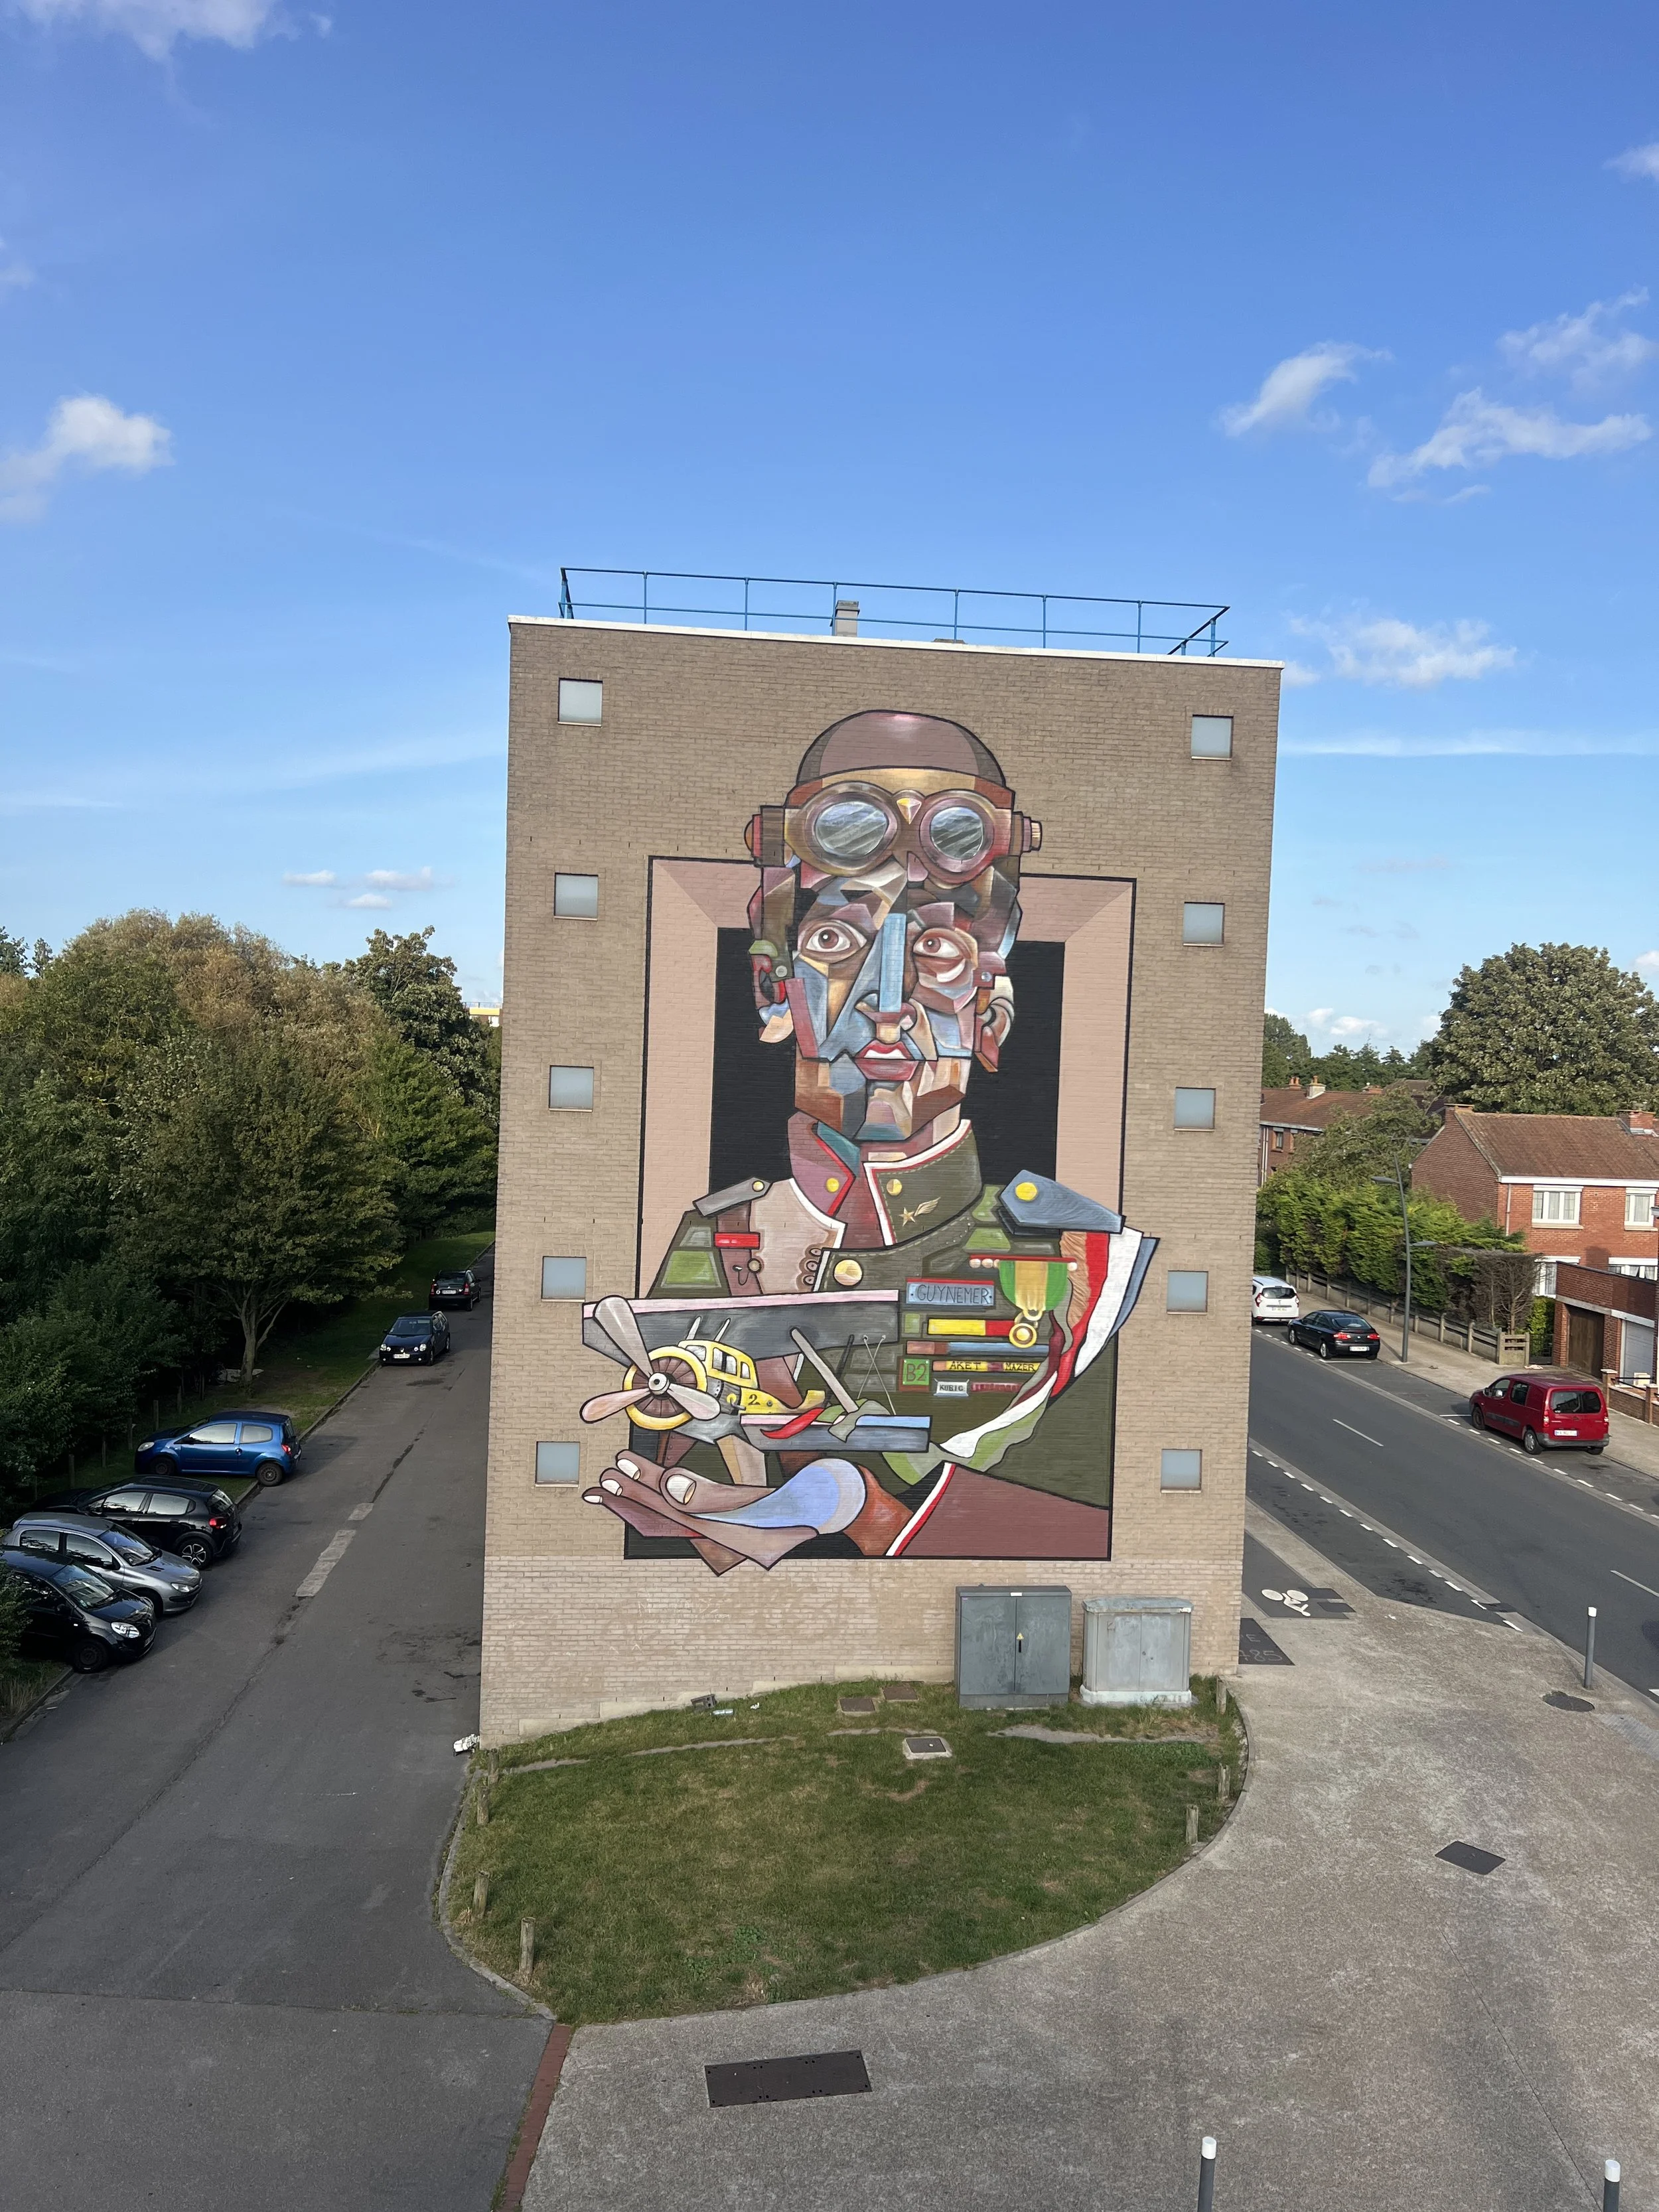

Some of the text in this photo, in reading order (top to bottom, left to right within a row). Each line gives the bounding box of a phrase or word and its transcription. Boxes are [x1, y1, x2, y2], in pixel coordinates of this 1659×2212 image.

[916, 1284, 990, 1305] GUYNEMER
[906, 1363, 926, 1382] B2
[949, 1360, 1037, 1372] AKET MAZER
[747, 1394, 761, 1406] 2
